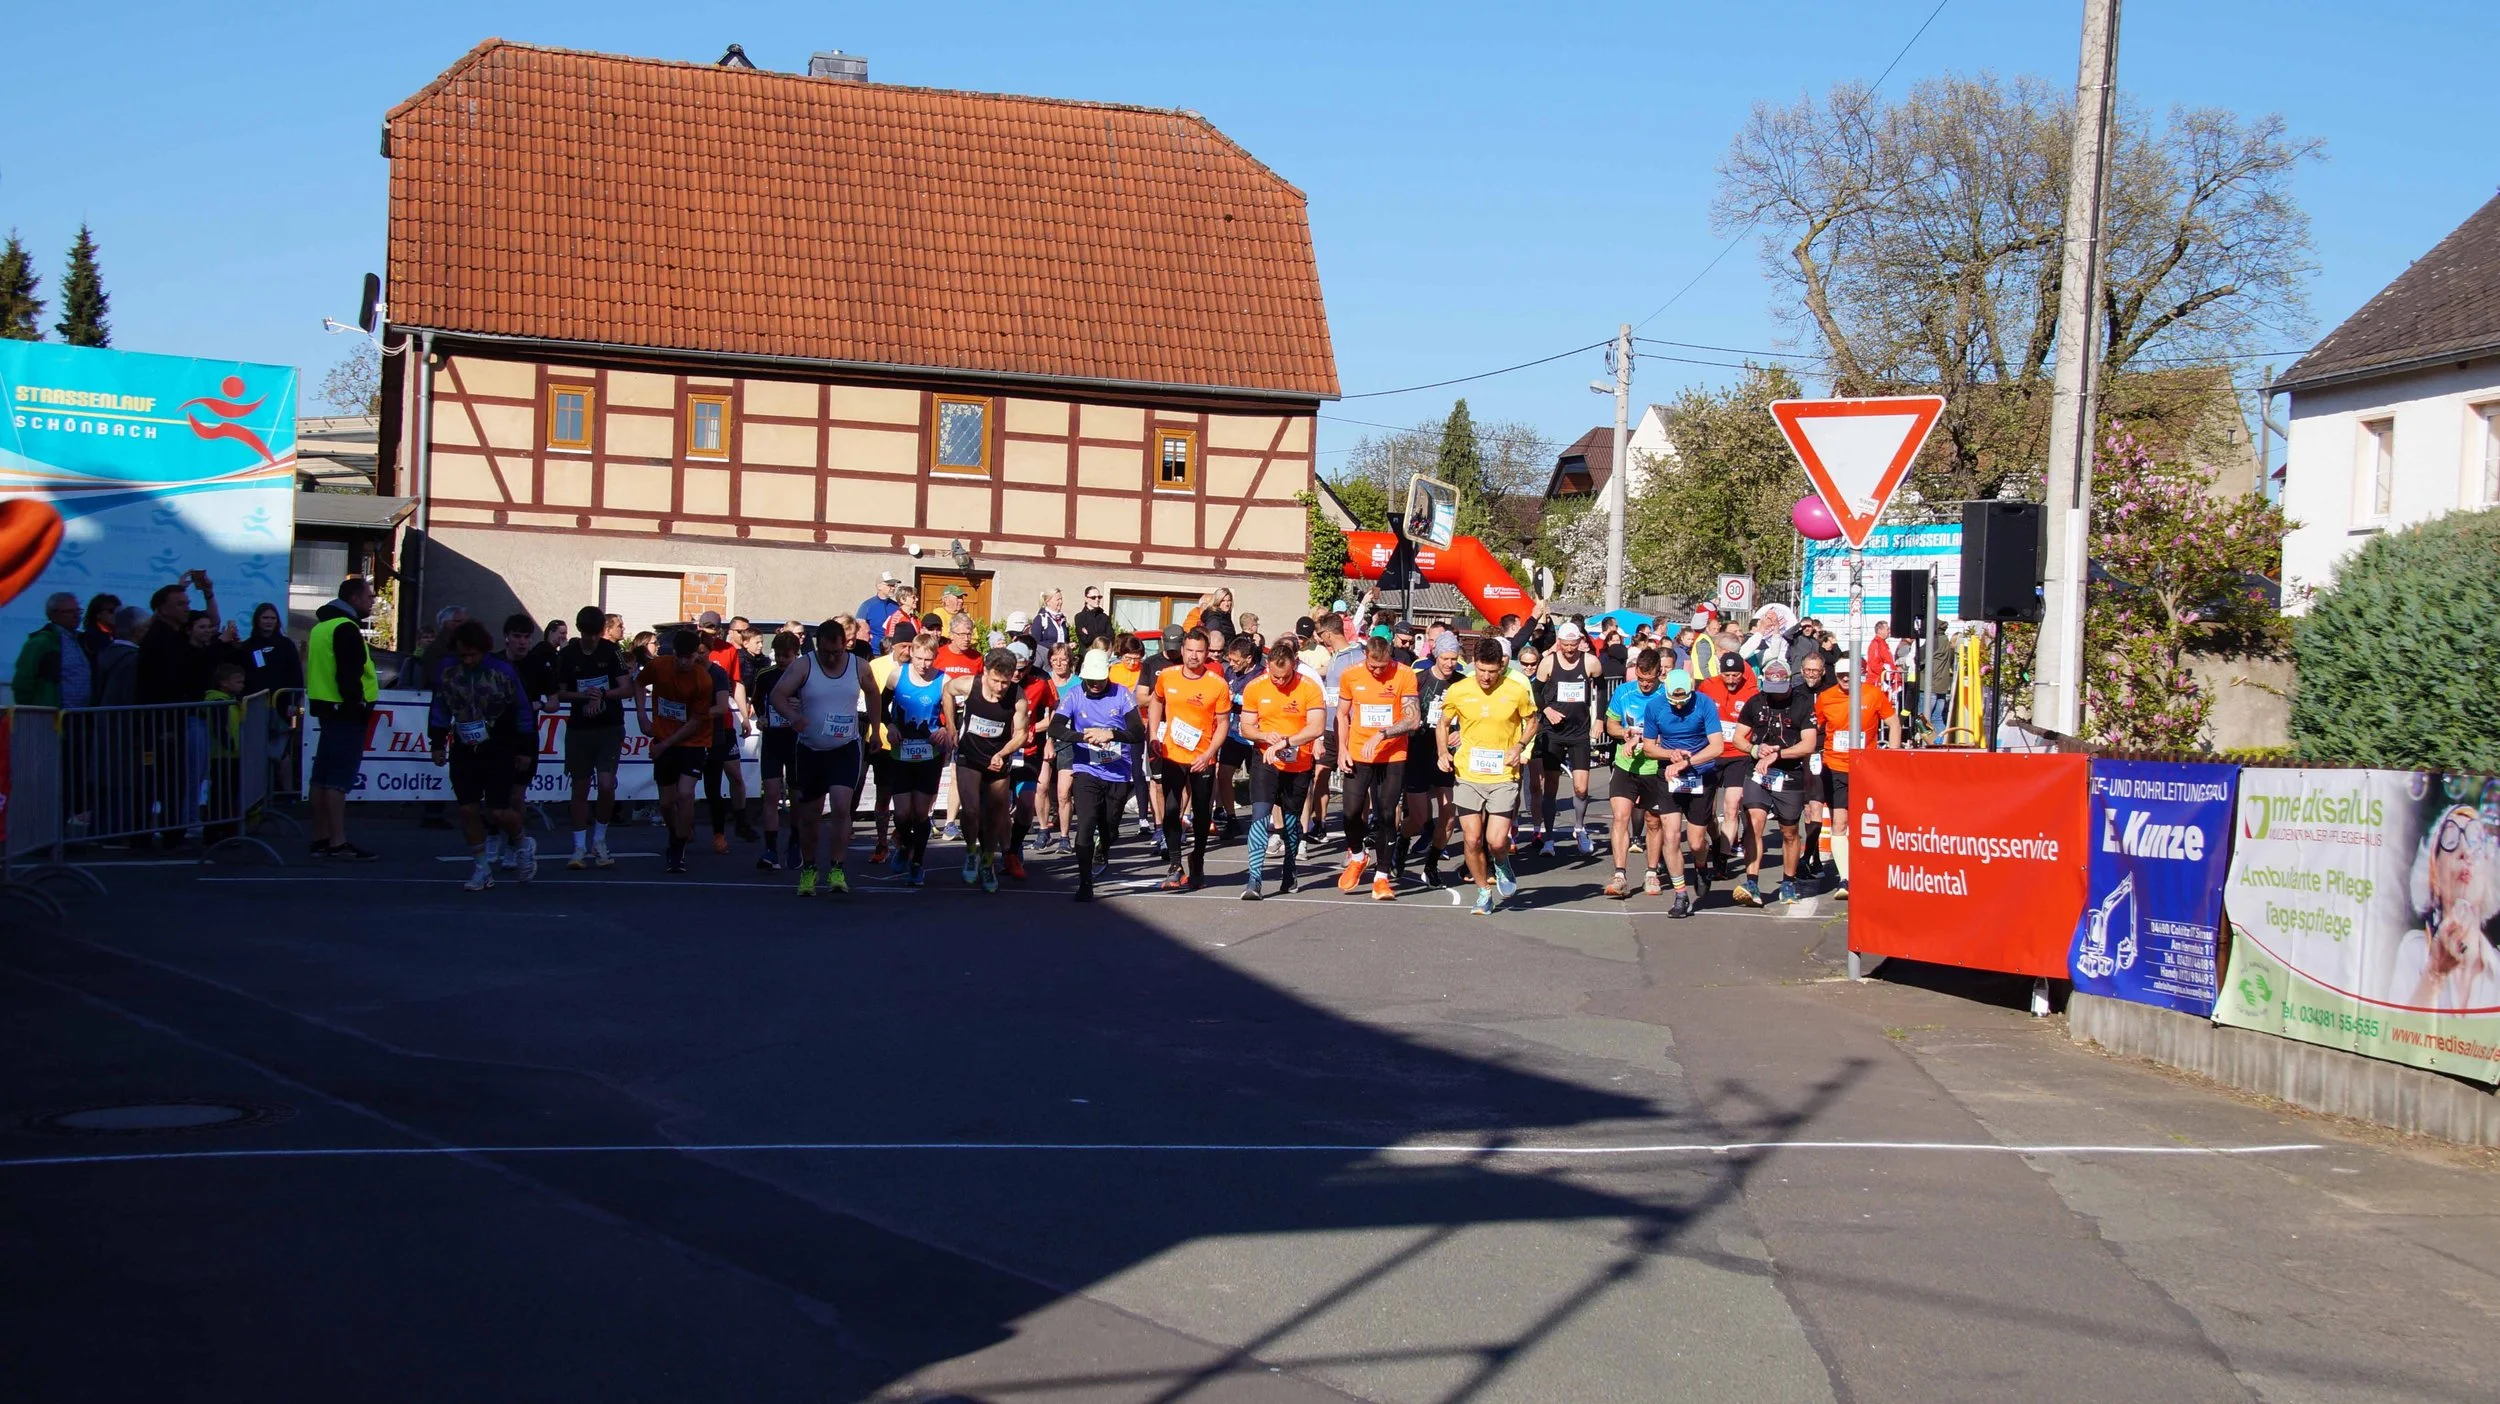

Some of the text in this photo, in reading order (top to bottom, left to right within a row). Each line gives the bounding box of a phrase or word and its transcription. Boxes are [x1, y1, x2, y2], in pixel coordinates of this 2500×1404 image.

[15, 385, 157, 412] STRASSENLAUF
[14, 415, 157, 439] SCHÖNBACH
[1729, 585, 1741, 596] 30
[829, 724, 849, 733] 1609
[975, 724, 996, 734] 1649
[1367, 714, 1386, 722] 1617
[1174, 730, 1191, 743] 1615
[905, 747, 928, 756] 1604
[1475, 759, 1498, 768] 1644
[377, 772, 443, 790] Colditz
[2109, 778, 2131, 798] UND
[2272, 788, 2384, 827] medisalus
[1886, 824, 2059, 864] Versicherungsservice
[2122, 810, 2205, 862] Kunze
[1887, 864, 1968, 896] Muldental
[2240, 864, 2374, 904] Ambulante Pflege
[2265, 900, 2352, 942] Tagespflege
[2281, 1000, 2296, 1020] Tel.
[2300, 1005, 2335, 1028] 034381
[2338, 1014, 2379, 1037] 55-555
[2391, 1025, 2500, 1062] www.medisalus.de
